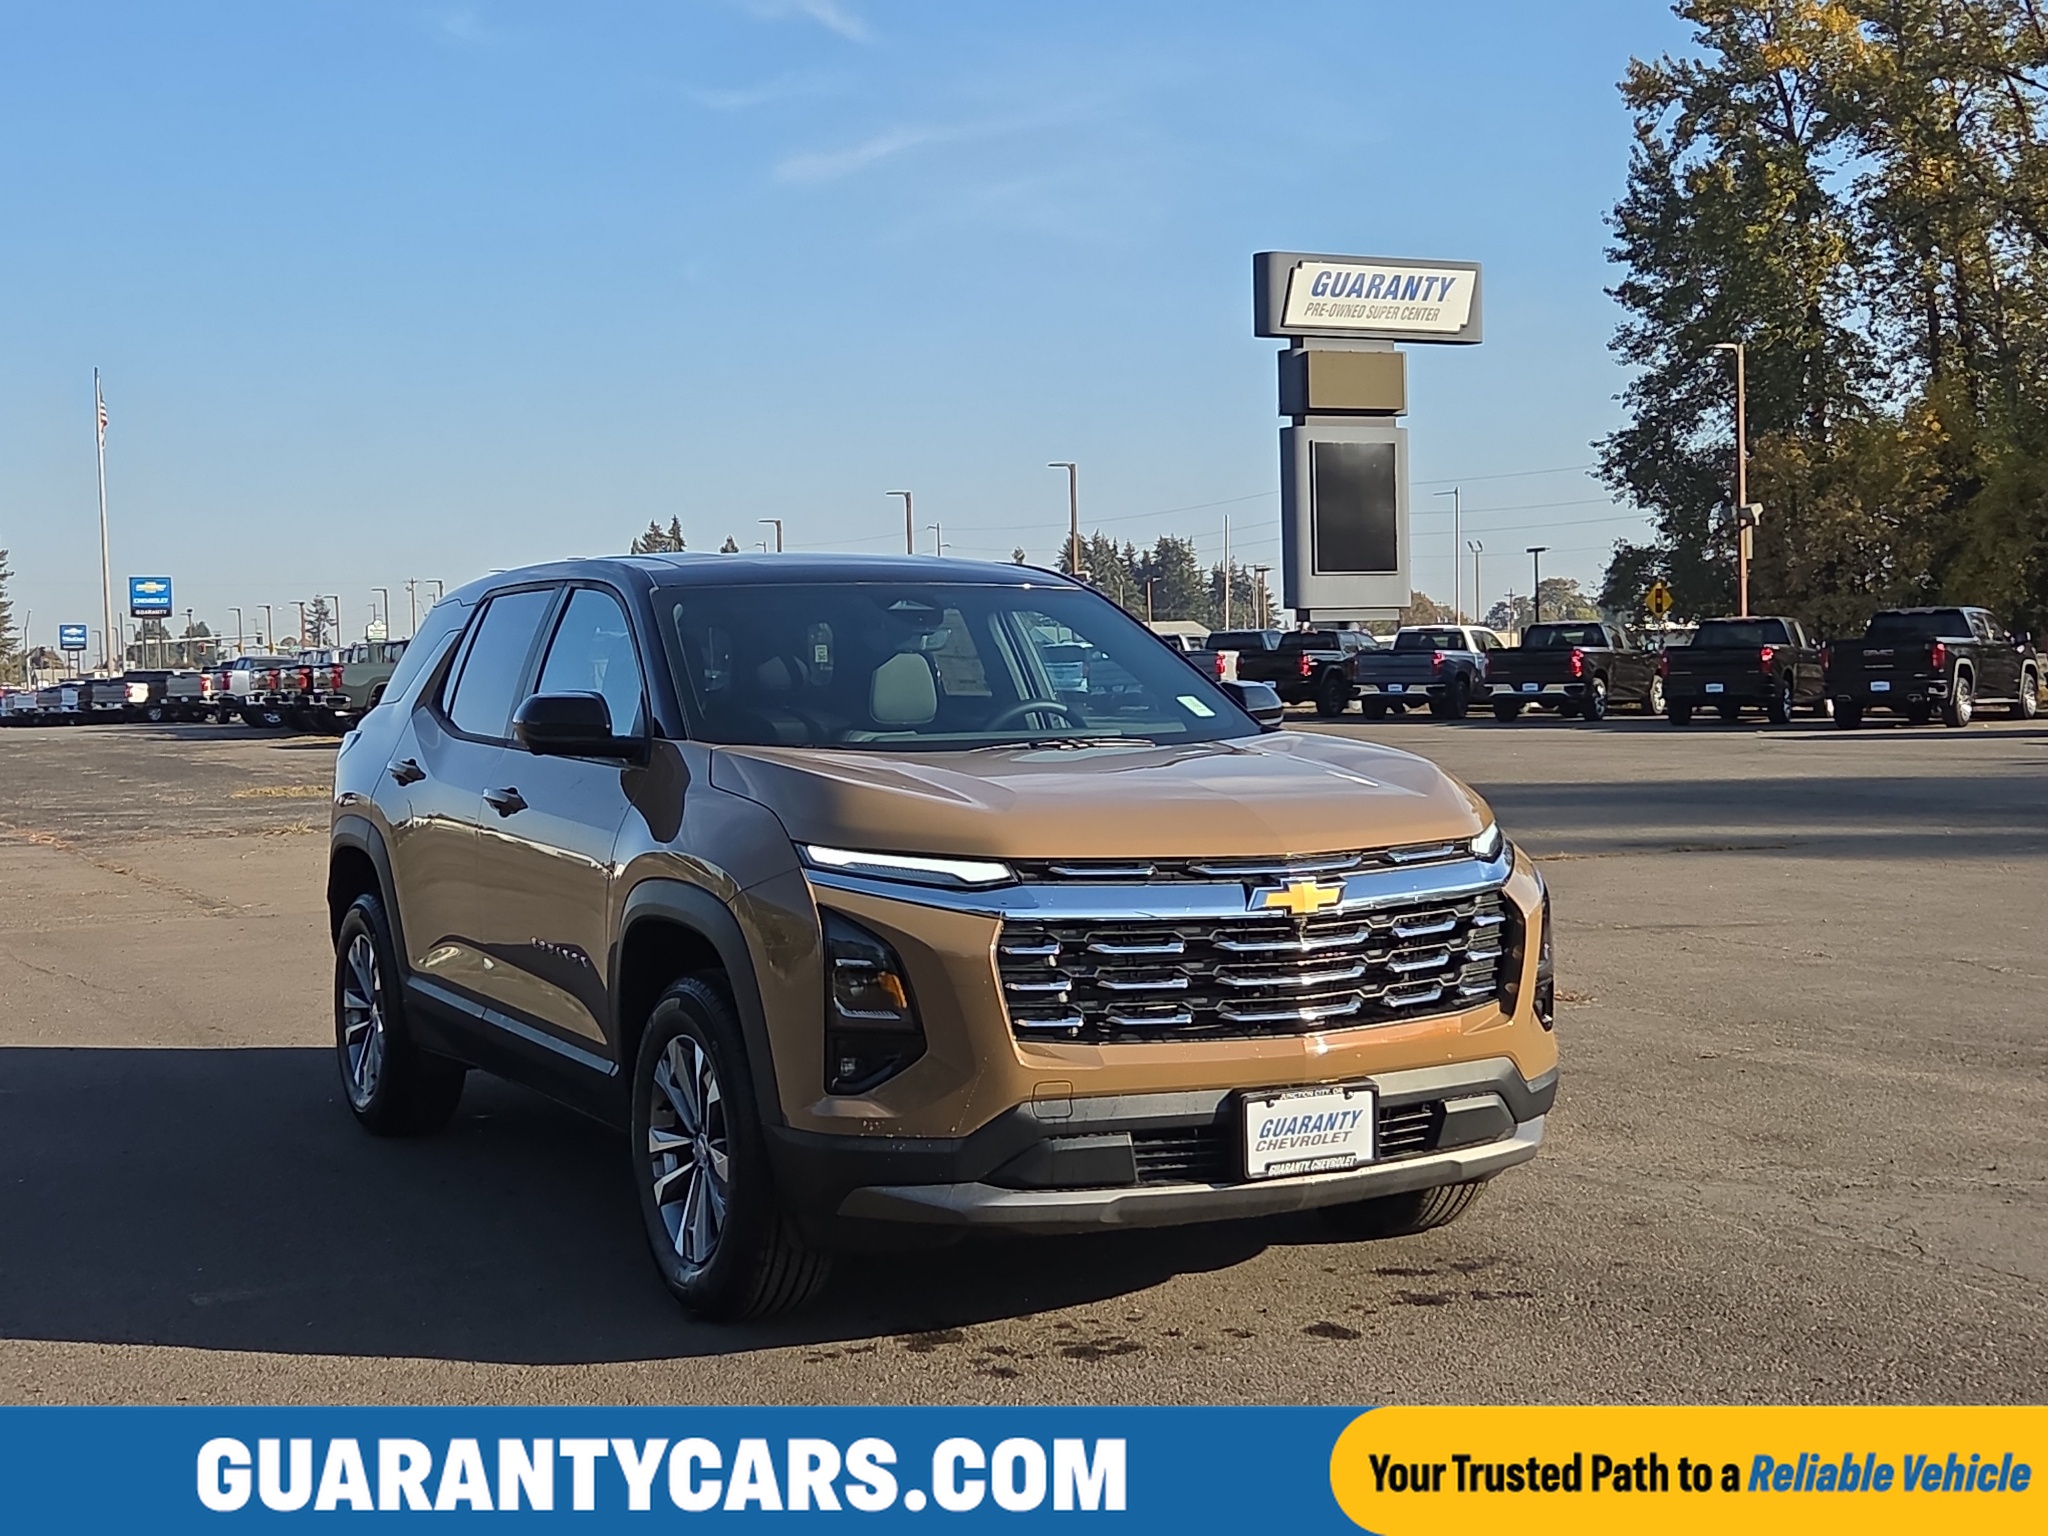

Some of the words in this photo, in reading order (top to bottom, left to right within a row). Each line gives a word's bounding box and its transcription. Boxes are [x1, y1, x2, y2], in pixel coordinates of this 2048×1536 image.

[1311, 270, 1456, 302] GUARANTY
[1304, 302, 1365, 319] PRE-OWNED
[1366, 305, 1400, 321] SUPER
[1400, 307, 1441, 323] CENTER
[1259, 1109, 1363, 1139] GUARANTY
[1255, 1130, 1352, 1152] CHEVROLET
